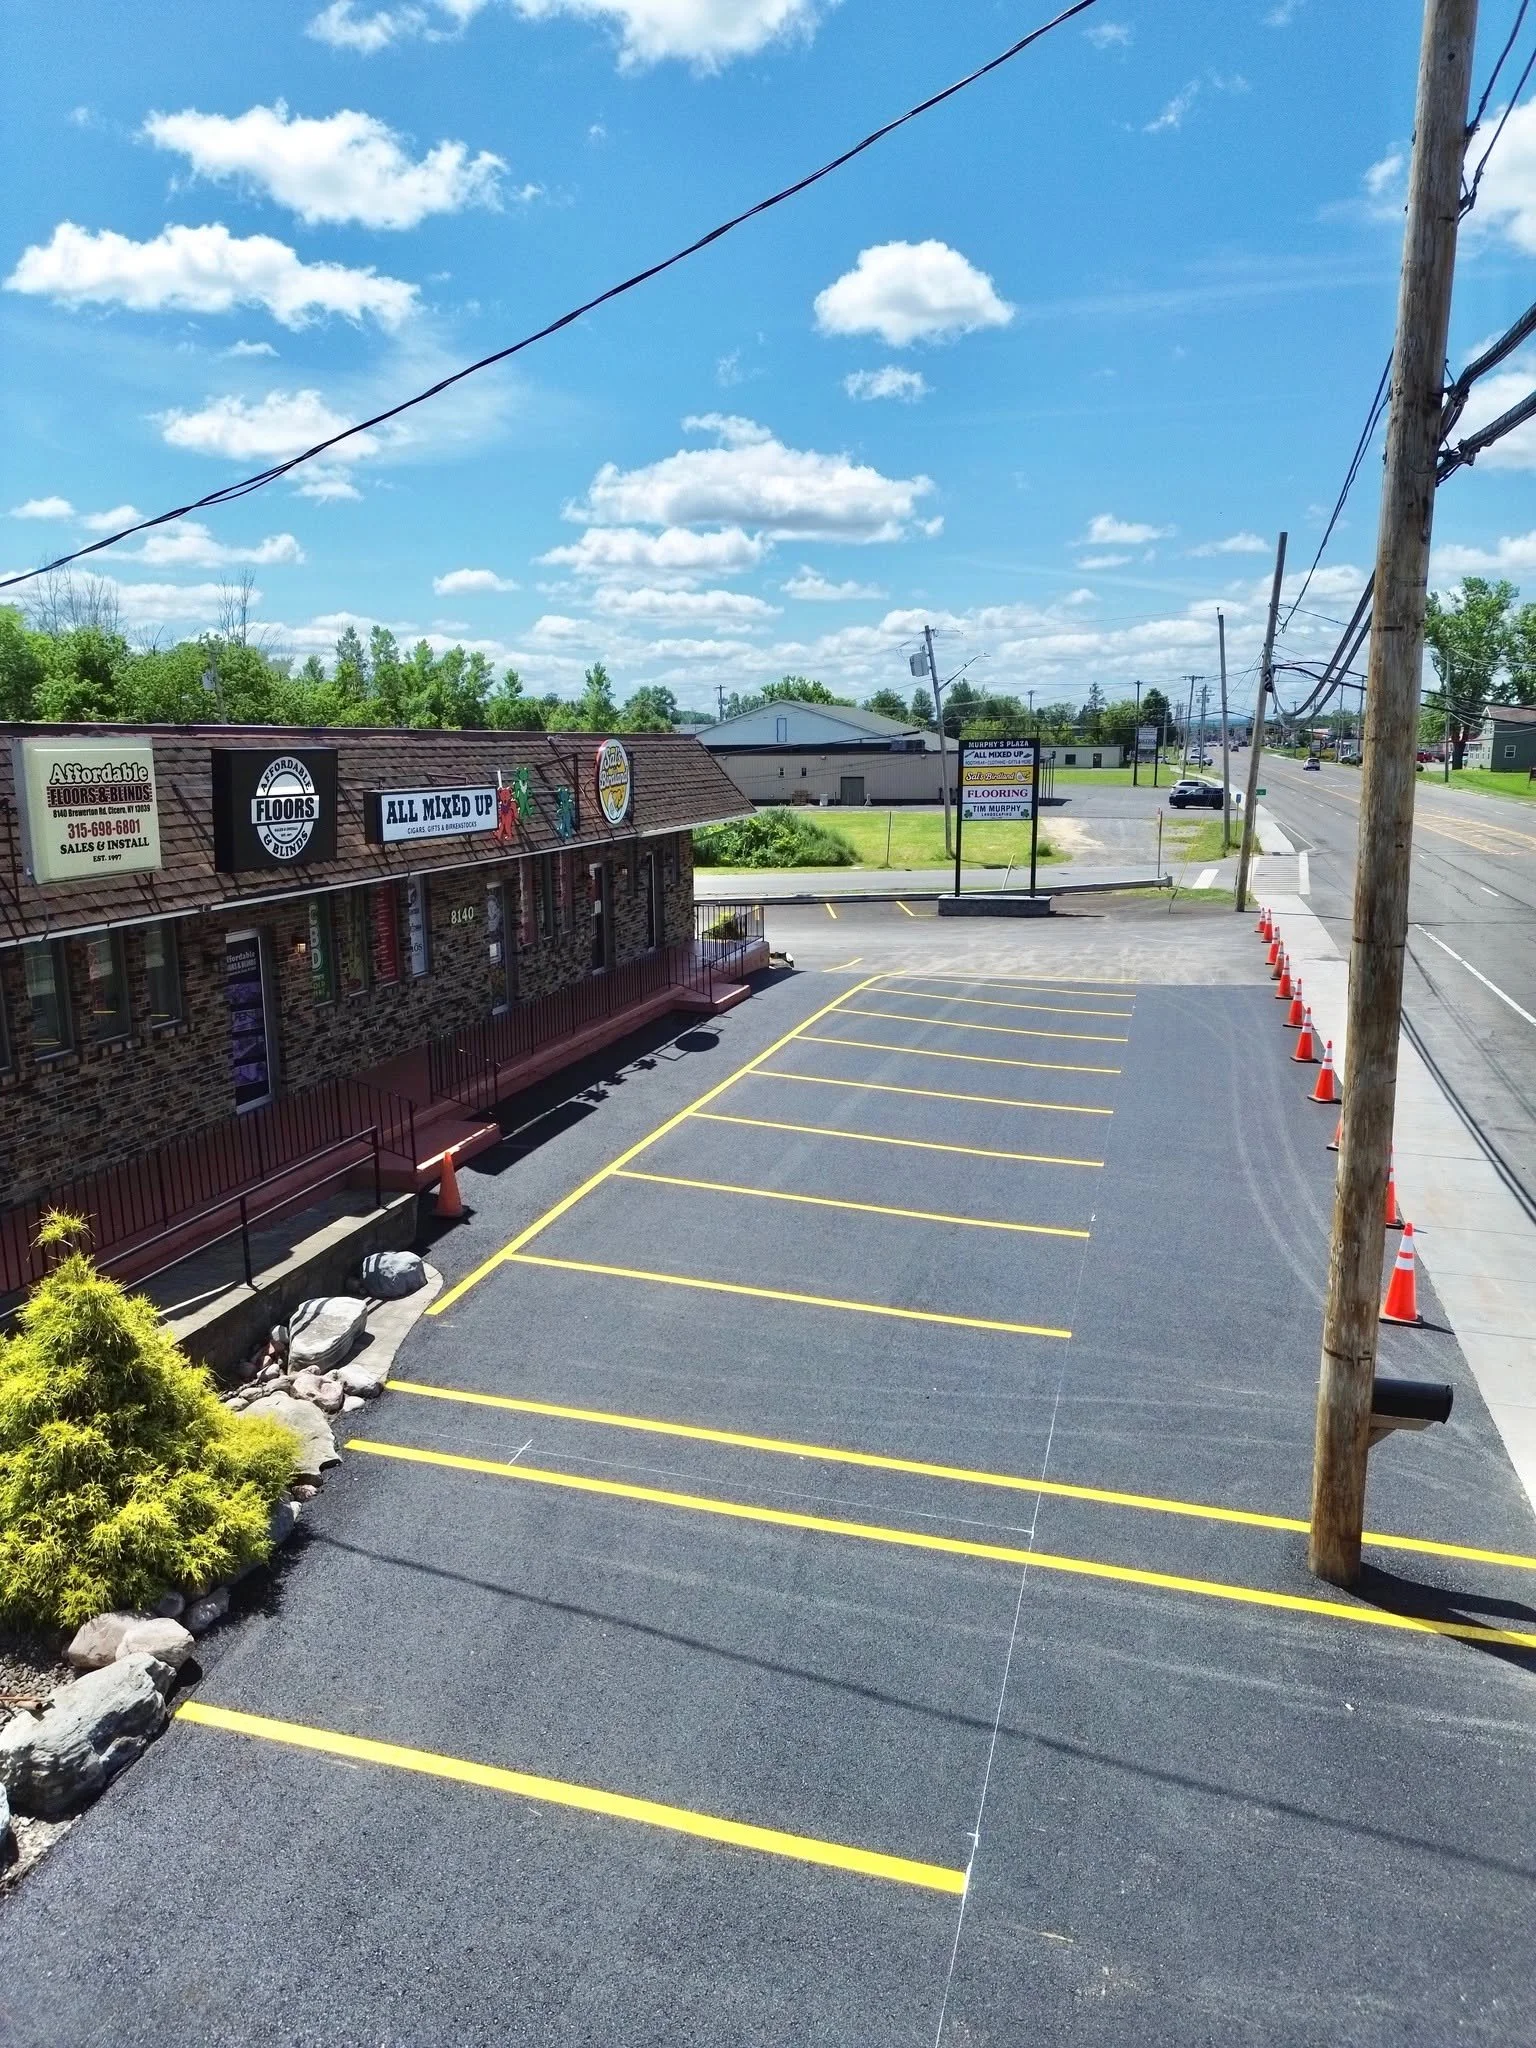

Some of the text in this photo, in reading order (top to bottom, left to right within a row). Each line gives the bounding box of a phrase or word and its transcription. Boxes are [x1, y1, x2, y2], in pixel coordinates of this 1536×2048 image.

[974, 750, 1024, 759] ALL MIXED UP
[50, 762, 149, 785] Affordable
[261, 759, 312, 793] AFFORDABLE
[966, 772, 1015, 782] Sal's Birdland
[50, 785, 151, 807] FLOORS & BLINDS
[967, 789, 1028, 798] FLOORING
[53, 809, 67, 818] 8140
[256, 797, 315, 822] FLOORS
[386, 794, 493, 824] ALL MIXED UP
[988, 805, 1021, 813] MURPHY
[68, 819, 141, 839] 315-698-6801
[427, 825, 440, 833] GIFTS
[446, 821, 477, 831] BIRKENSTOCKS
[60, 837, 150, 855] SALES & INSTALL
[272, 830, 309, 857] BLINDS
[451, 906, 474, 925] 8140
